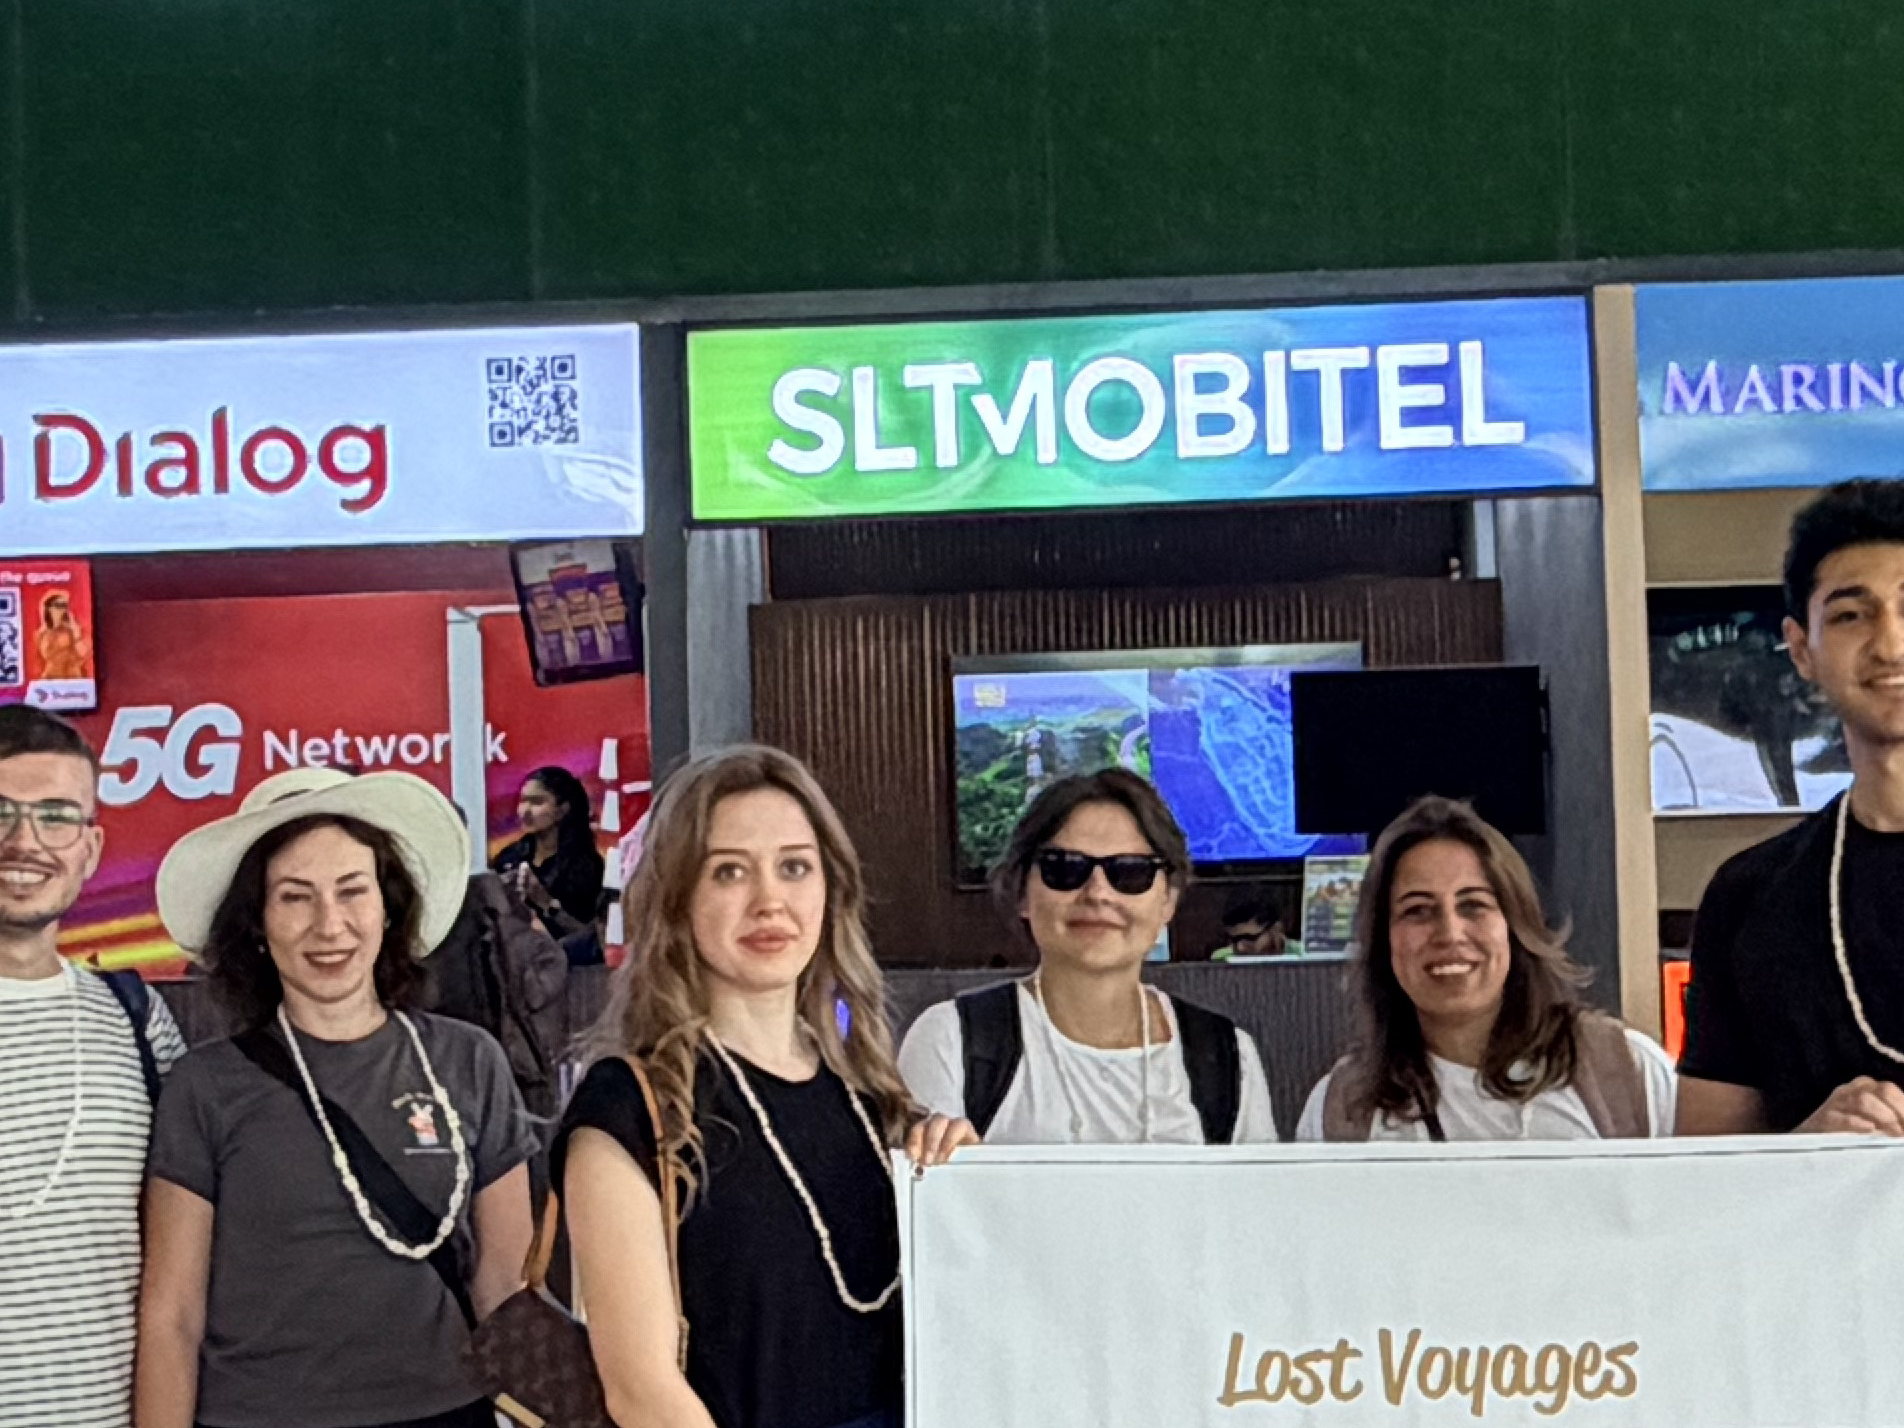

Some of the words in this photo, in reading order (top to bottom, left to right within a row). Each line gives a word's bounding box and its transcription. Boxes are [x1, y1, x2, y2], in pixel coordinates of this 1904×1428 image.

[32, 405, 388, 512] Dialog
[97, 702, 243, 806] 5G
[1216, 1332, 1363, 1407] Lost
[1378, 1328, 1640, 1417] Voyages
